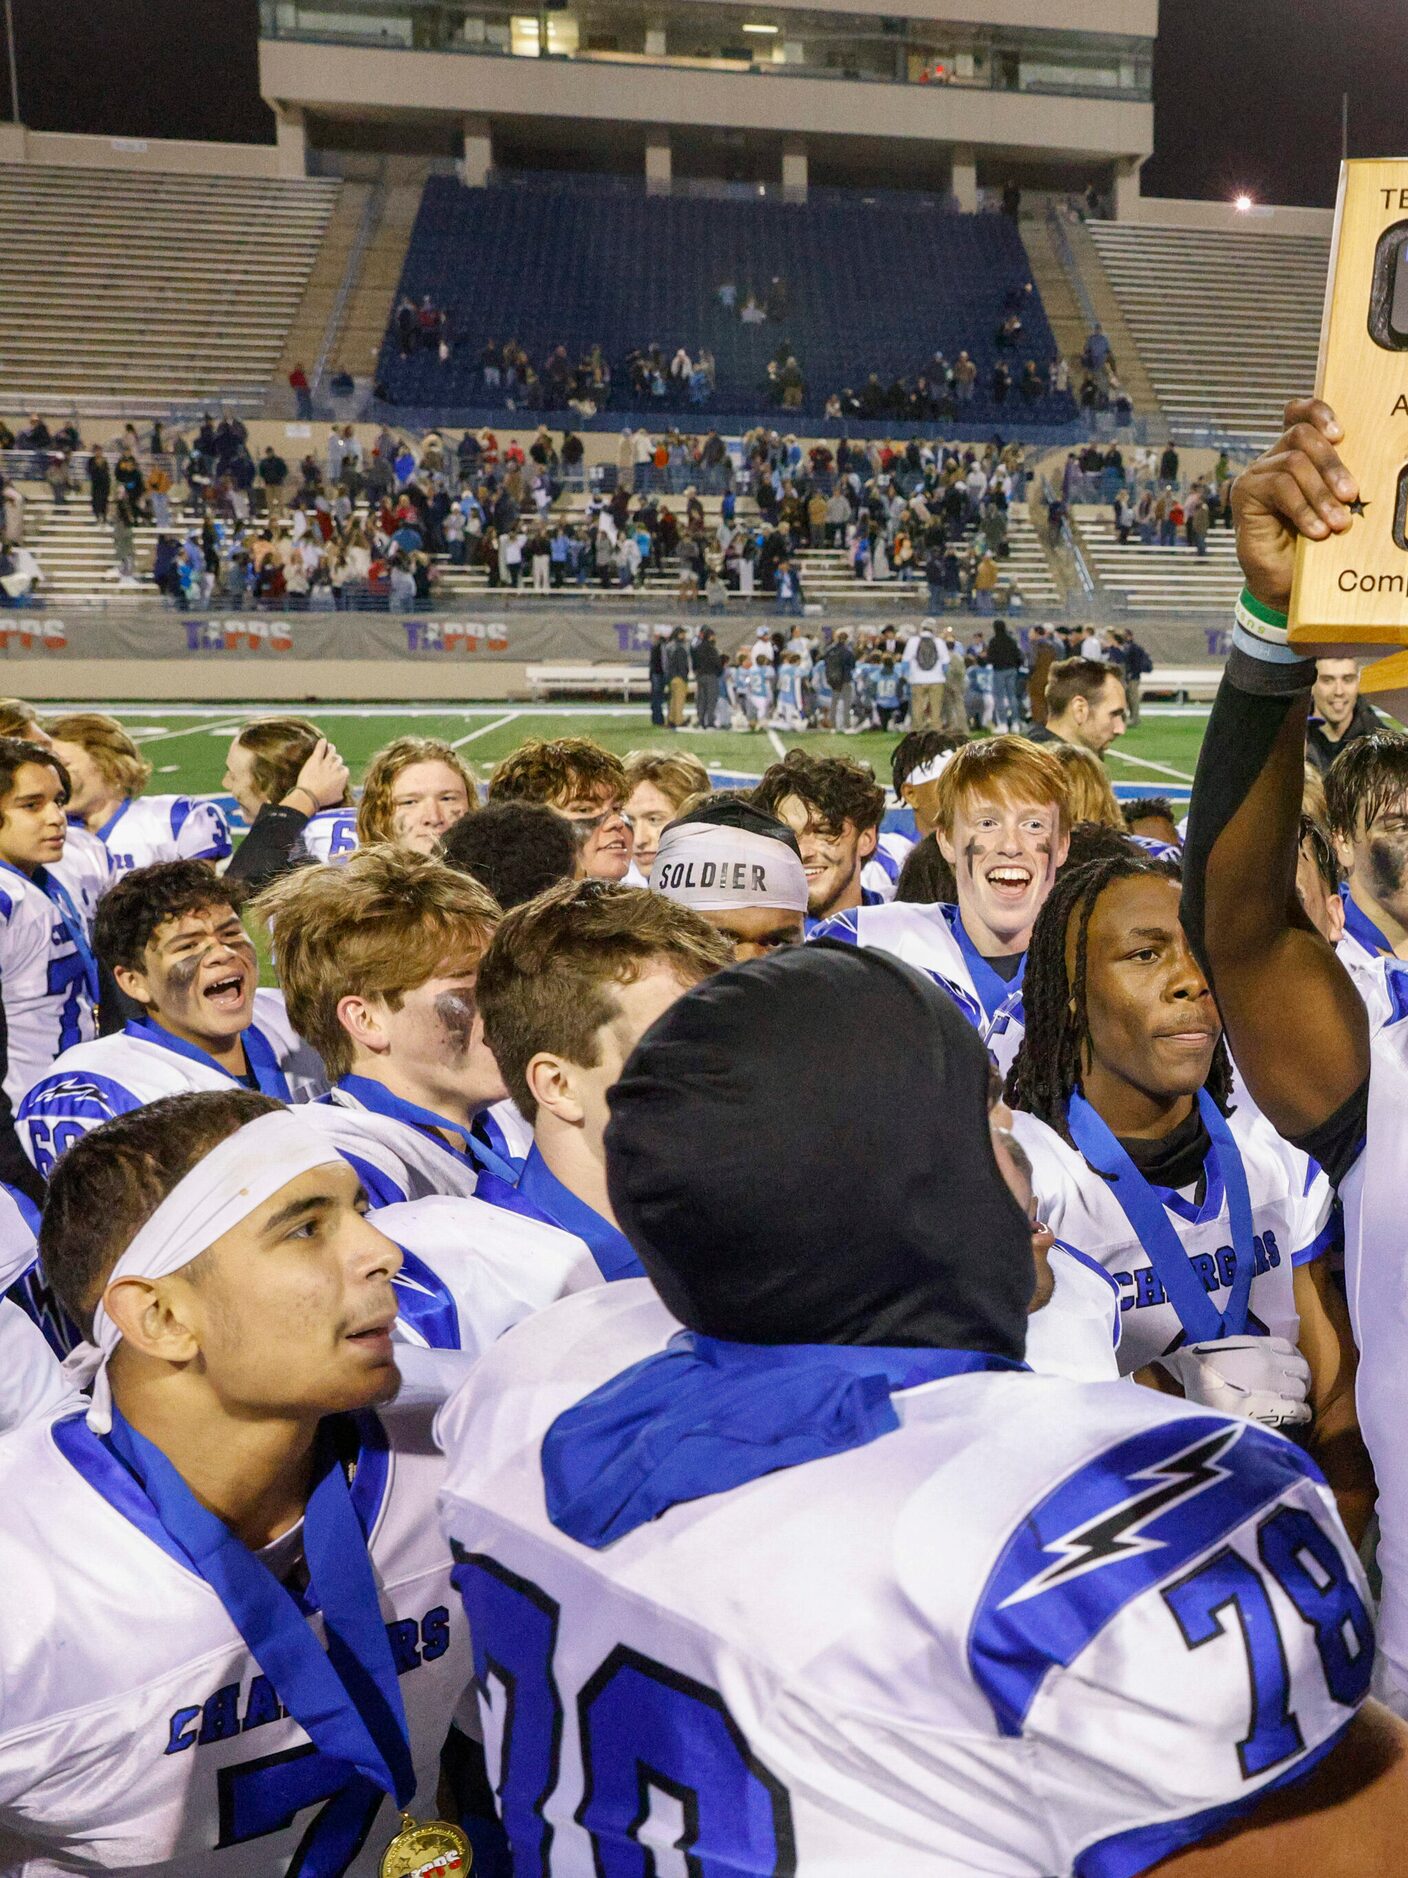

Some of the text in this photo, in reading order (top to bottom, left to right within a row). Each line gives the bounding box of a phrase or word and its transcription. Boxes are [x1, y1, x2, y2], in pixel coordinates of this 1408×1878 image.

[0, 618, 67, 649] PPS
[402, 621, 508, 652] TAPPS
[659, 861, 767, 892] SOLDIER
[1159, 1502, 1376, 1780] 78
[165, 1604, 450, 1756] CHARS
